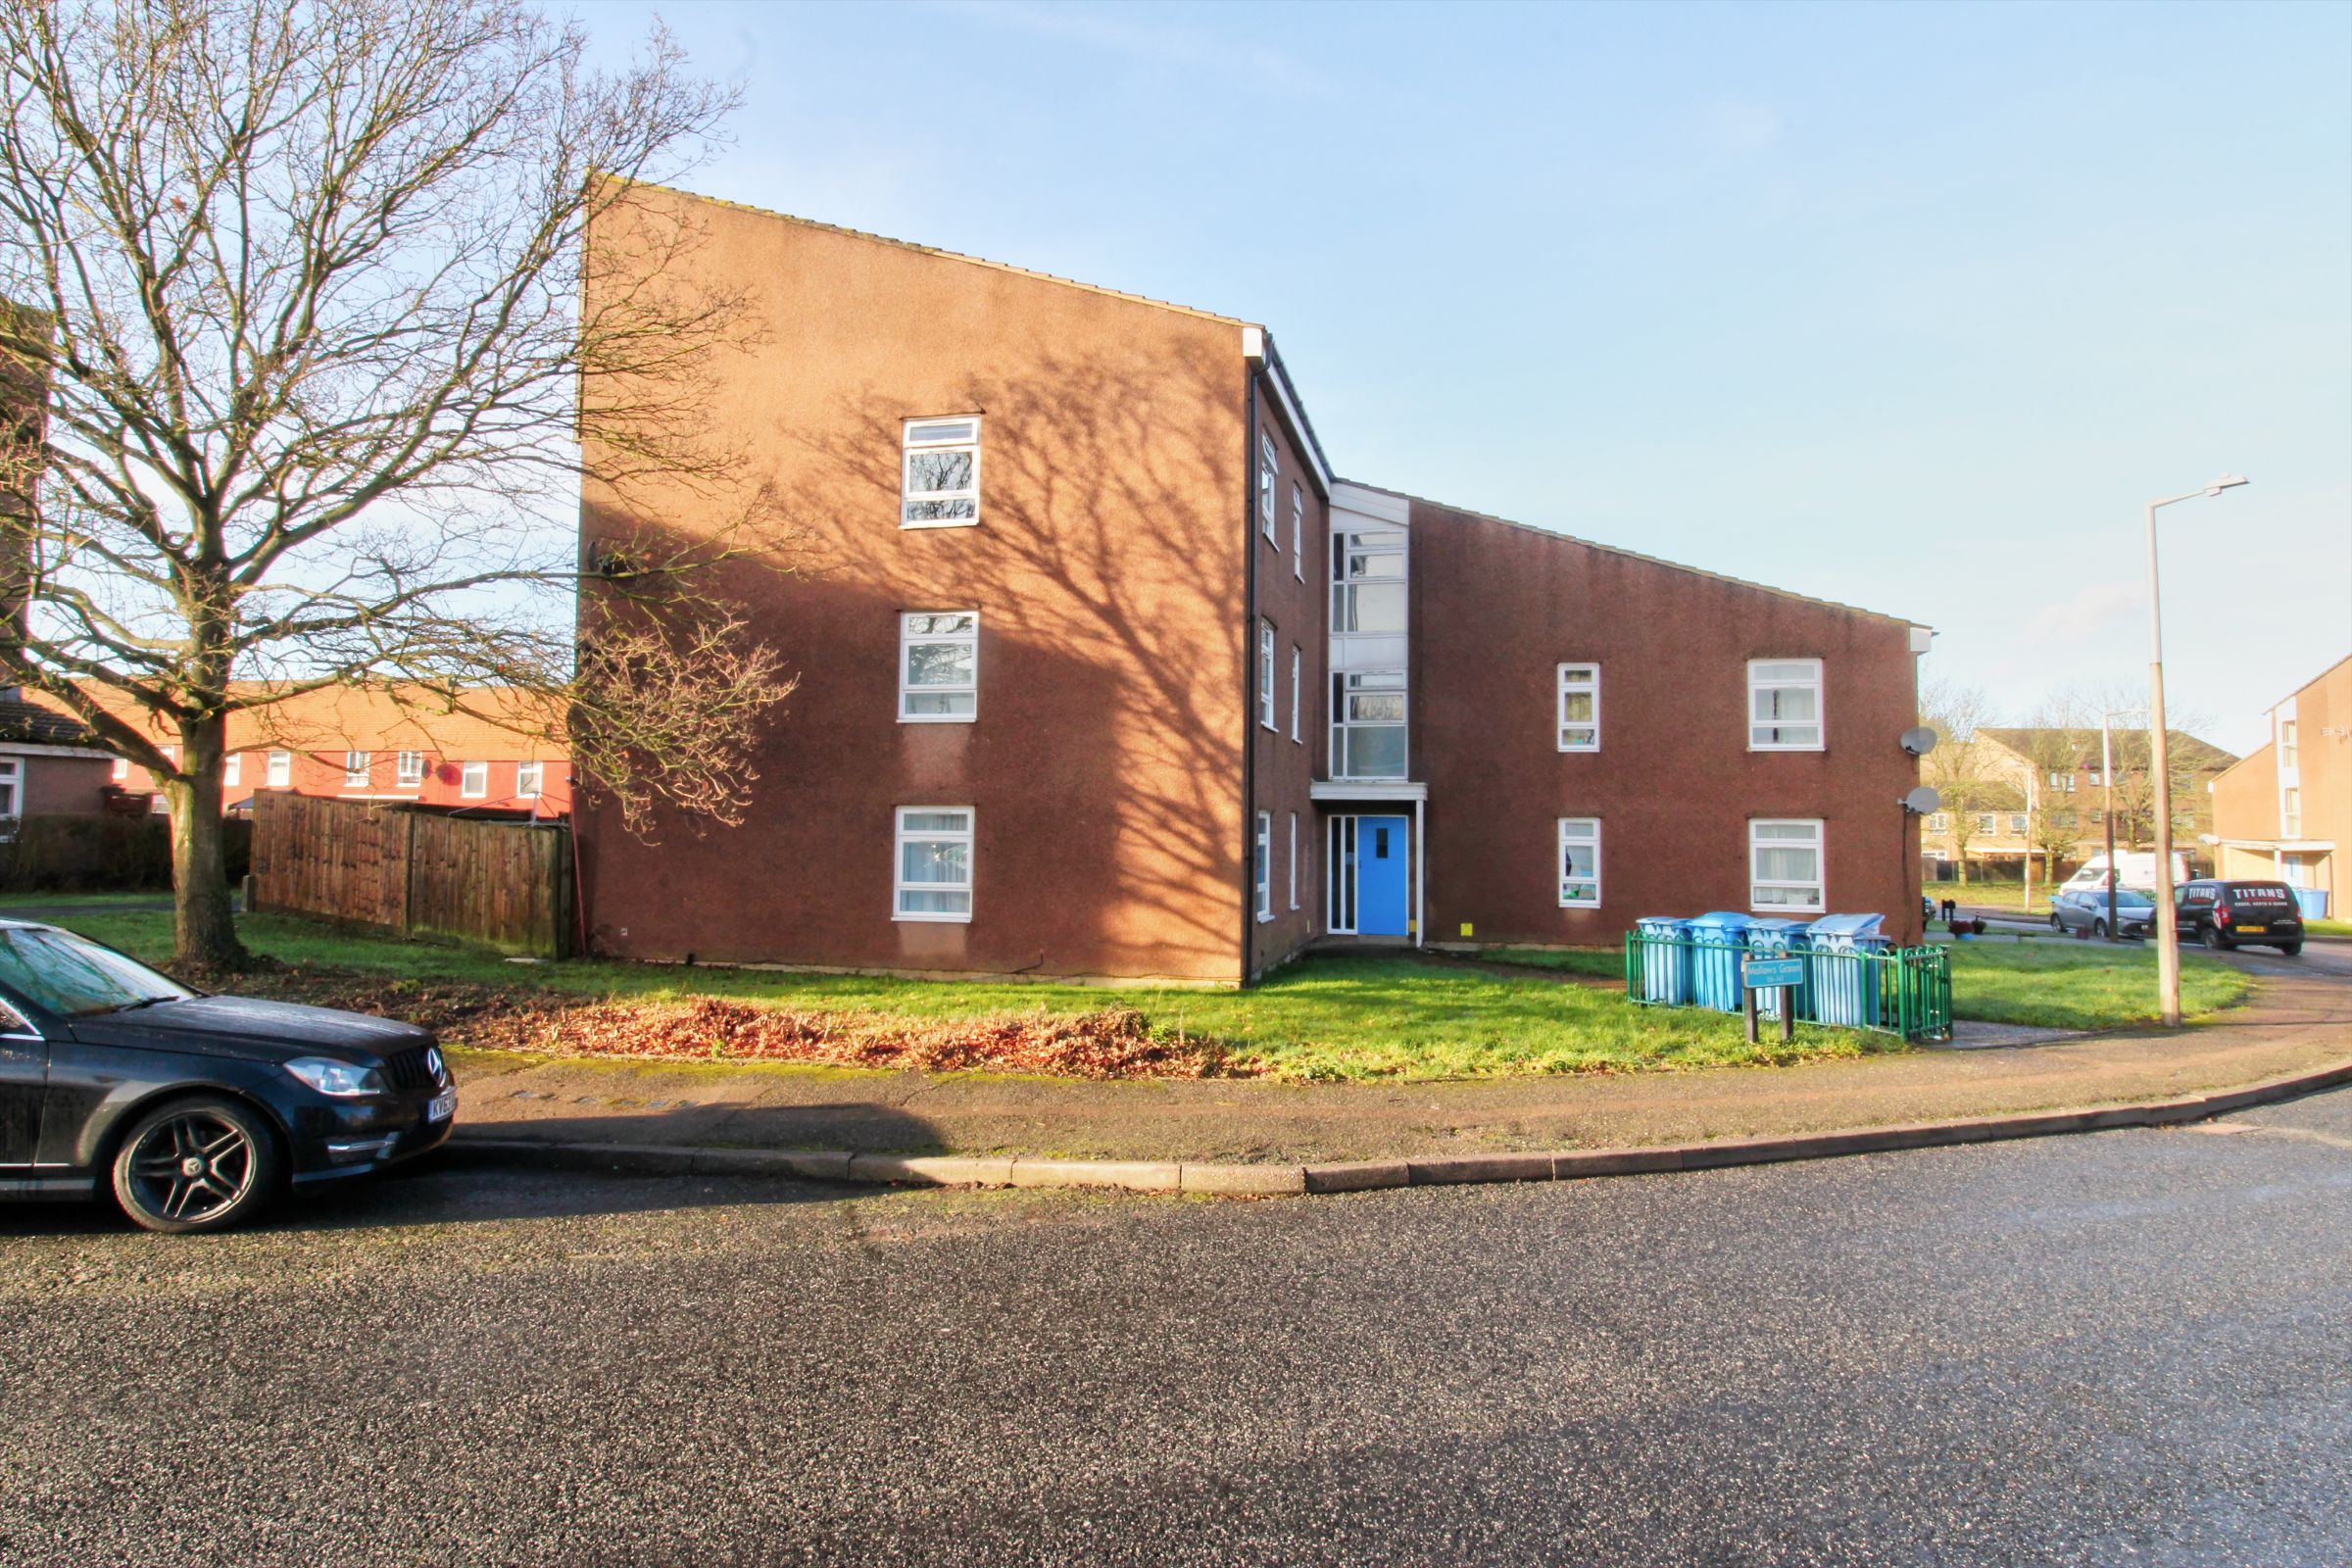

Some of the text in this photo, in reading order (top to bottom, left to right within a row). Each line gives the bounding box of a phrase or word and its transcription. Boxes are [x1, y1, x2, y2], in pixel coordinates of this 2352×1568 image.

[2188, 888, 2216, 900] TITANS
[2232, 888, 2285, 899] TITANS
[1748, 964, 1801, 975] Mallows Green
